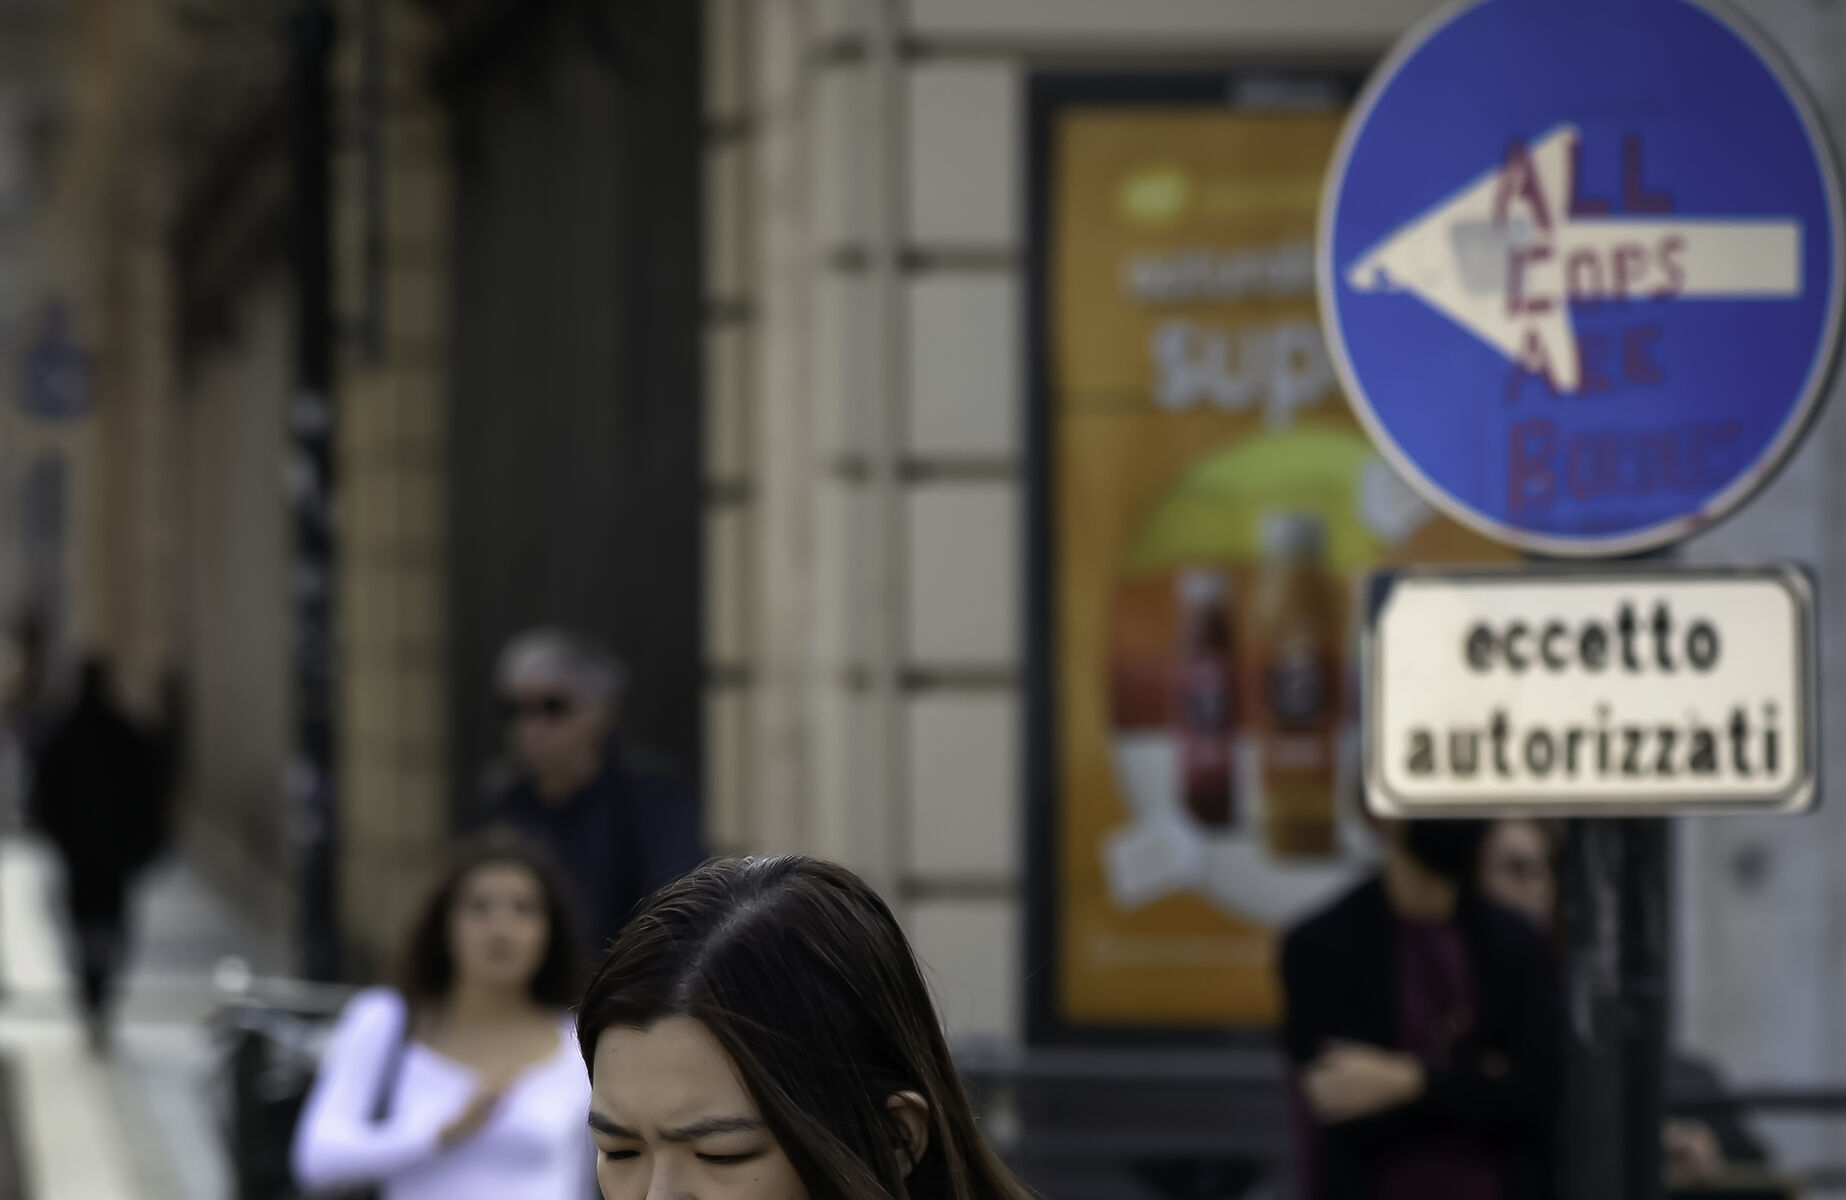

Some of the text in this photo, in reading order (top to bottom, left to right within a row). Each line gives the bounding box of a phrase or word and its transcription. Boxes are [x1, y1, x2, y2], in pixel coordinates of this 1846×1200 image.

[1494, 135, 1673, 231] ALL
[1150, 318, 1333, 432] sup
[1464, 600, 1722, 673] eccetto
[1405, 704, 1780, 776] autorizzati
